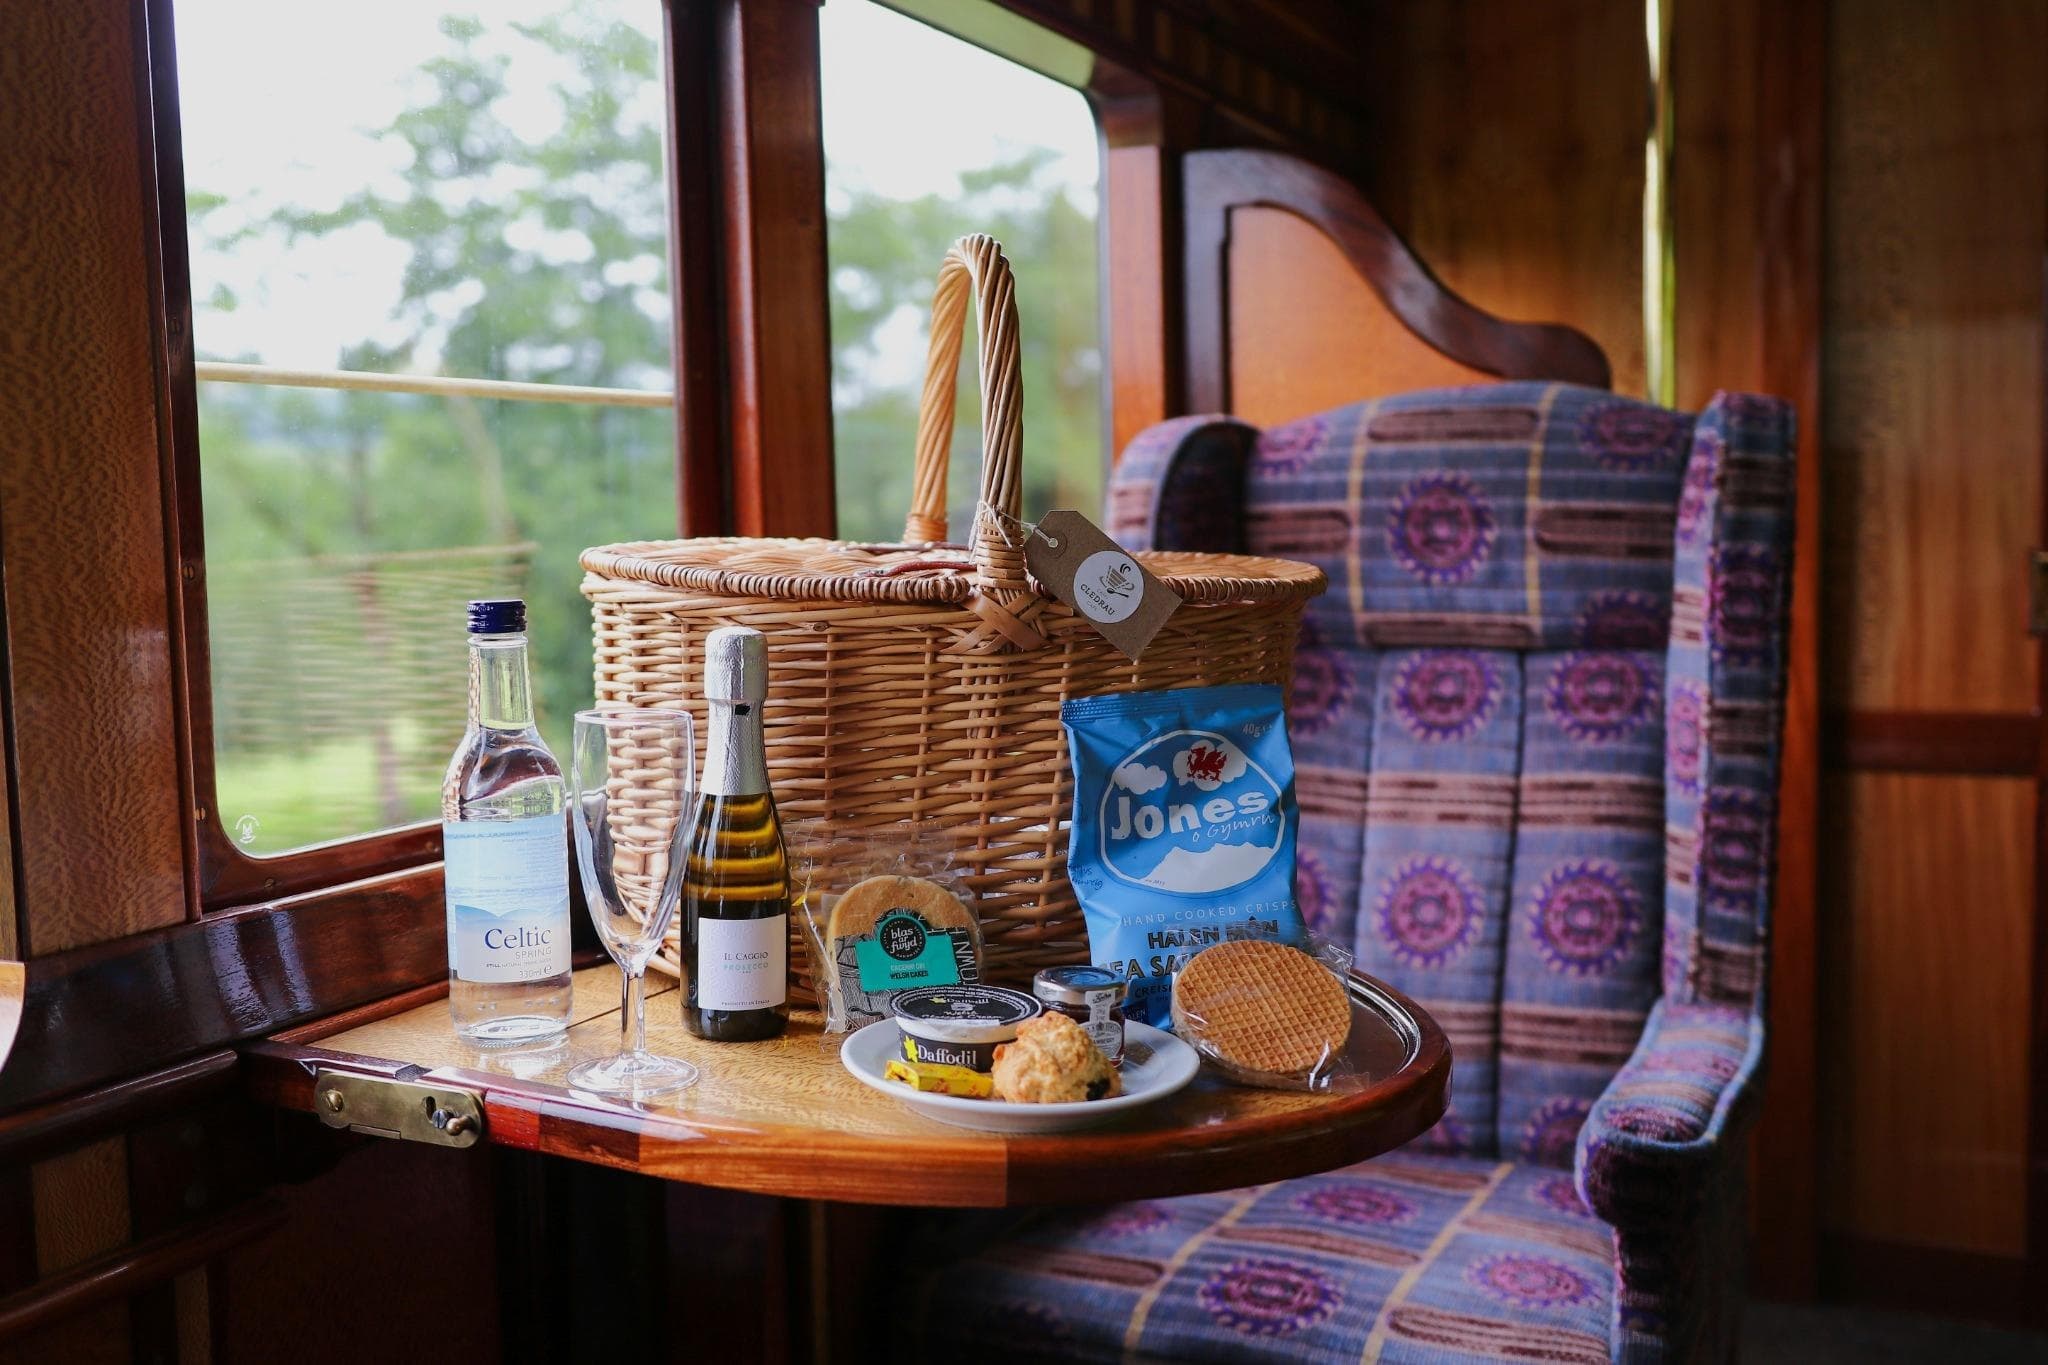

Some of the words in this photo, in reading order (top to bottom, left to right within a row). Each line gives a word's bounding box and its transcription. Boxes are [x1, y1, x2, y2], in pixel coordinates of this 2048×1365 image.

[1081, 584, 1115, 615] CLEDRAU
[1111, 791, 1269, 840] Jones
[1207, 814, 1275, 841] Gymru
[1122, 913, 1166, 927] HAND
[1175, 906, 1237, 921] COOKED
[1246, 901, 1296, 914] CRISPS
[485, 926, 551, 949] Celtic
[891, 927, 914, 939] blas
[1147, 927, 1220, 949] HALEN
[515, 946, 552, 960] SPRING
[723, 962, 769, 971] PROSECCO
[1101, 958, 1145, 980] EA
[918, 1043, 977, 1065] Daffodil
